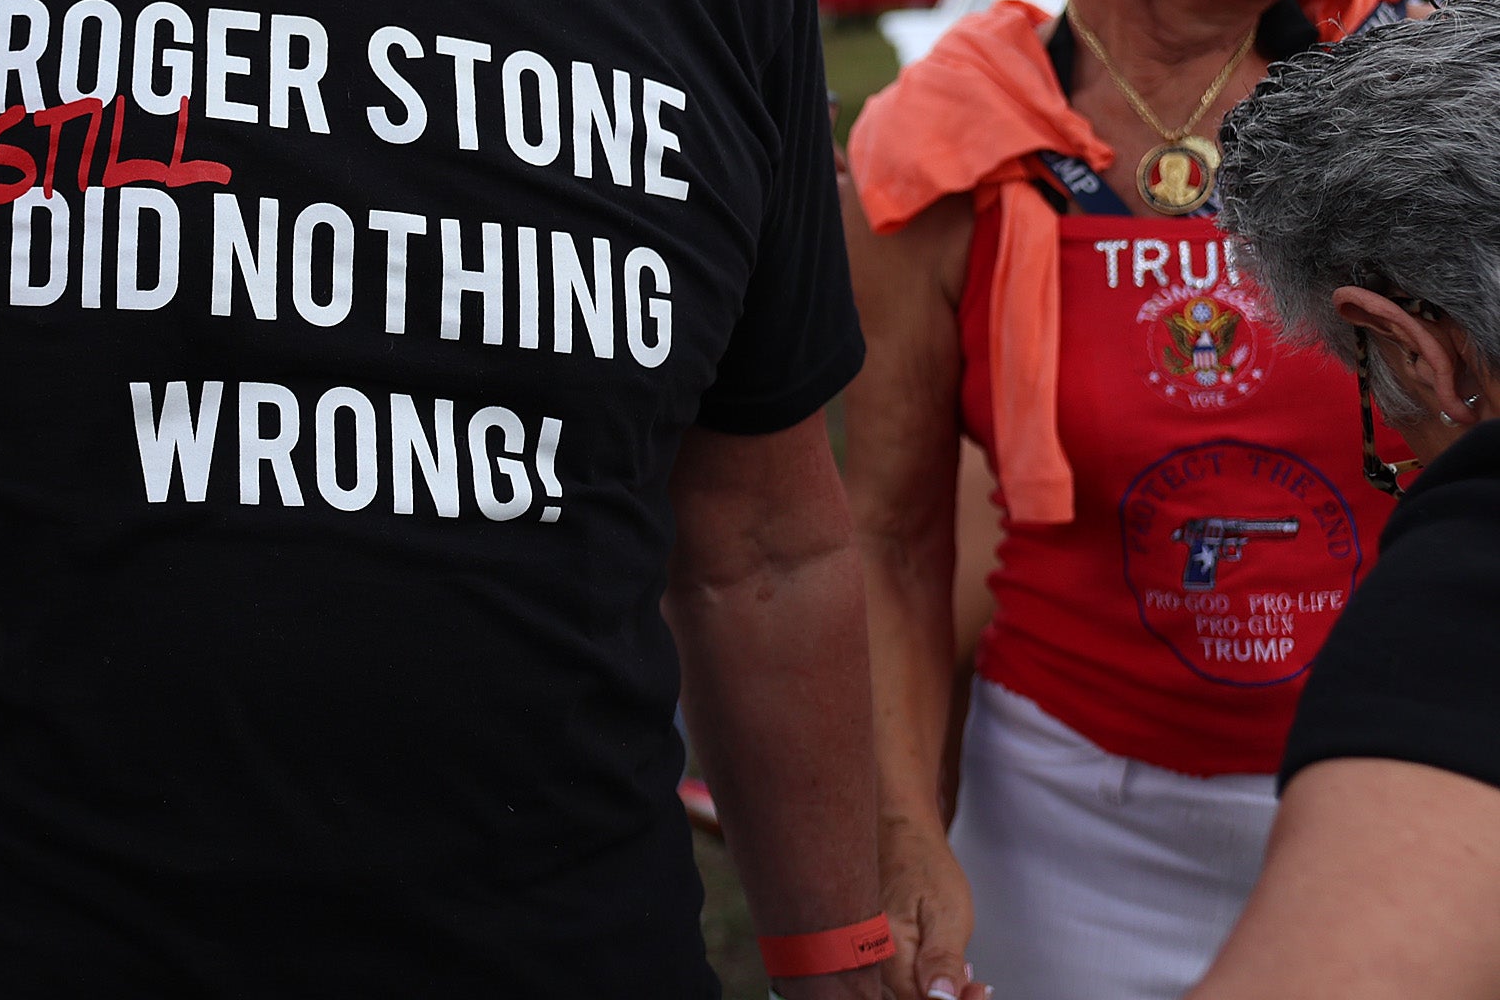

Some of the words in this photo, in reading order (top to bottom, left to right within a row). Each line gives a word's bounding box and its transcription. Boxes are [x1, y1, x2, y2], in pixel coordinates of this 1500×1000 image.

[367, 26, 690, 201] STONE
[9, 186, 181, 311] DID
[210, 193, 672, 369] NOTHING
[1094, 239, 1242, 289] TRU
[1188, 390, 1226, 408] VOTE
[129, 380, 563, 523] WRONG!
[1130, 452, 1224, 556] PROTECT
[1249, 453, 1317, 501] THE
[1312, 500, 1352, 560] 2ND
[1195, 614, 1295, 636] PRO-GUN
[1249, 590, 1344, 614] PRO-LIFE
[1198, 637, 1296, 663] TRUMP
